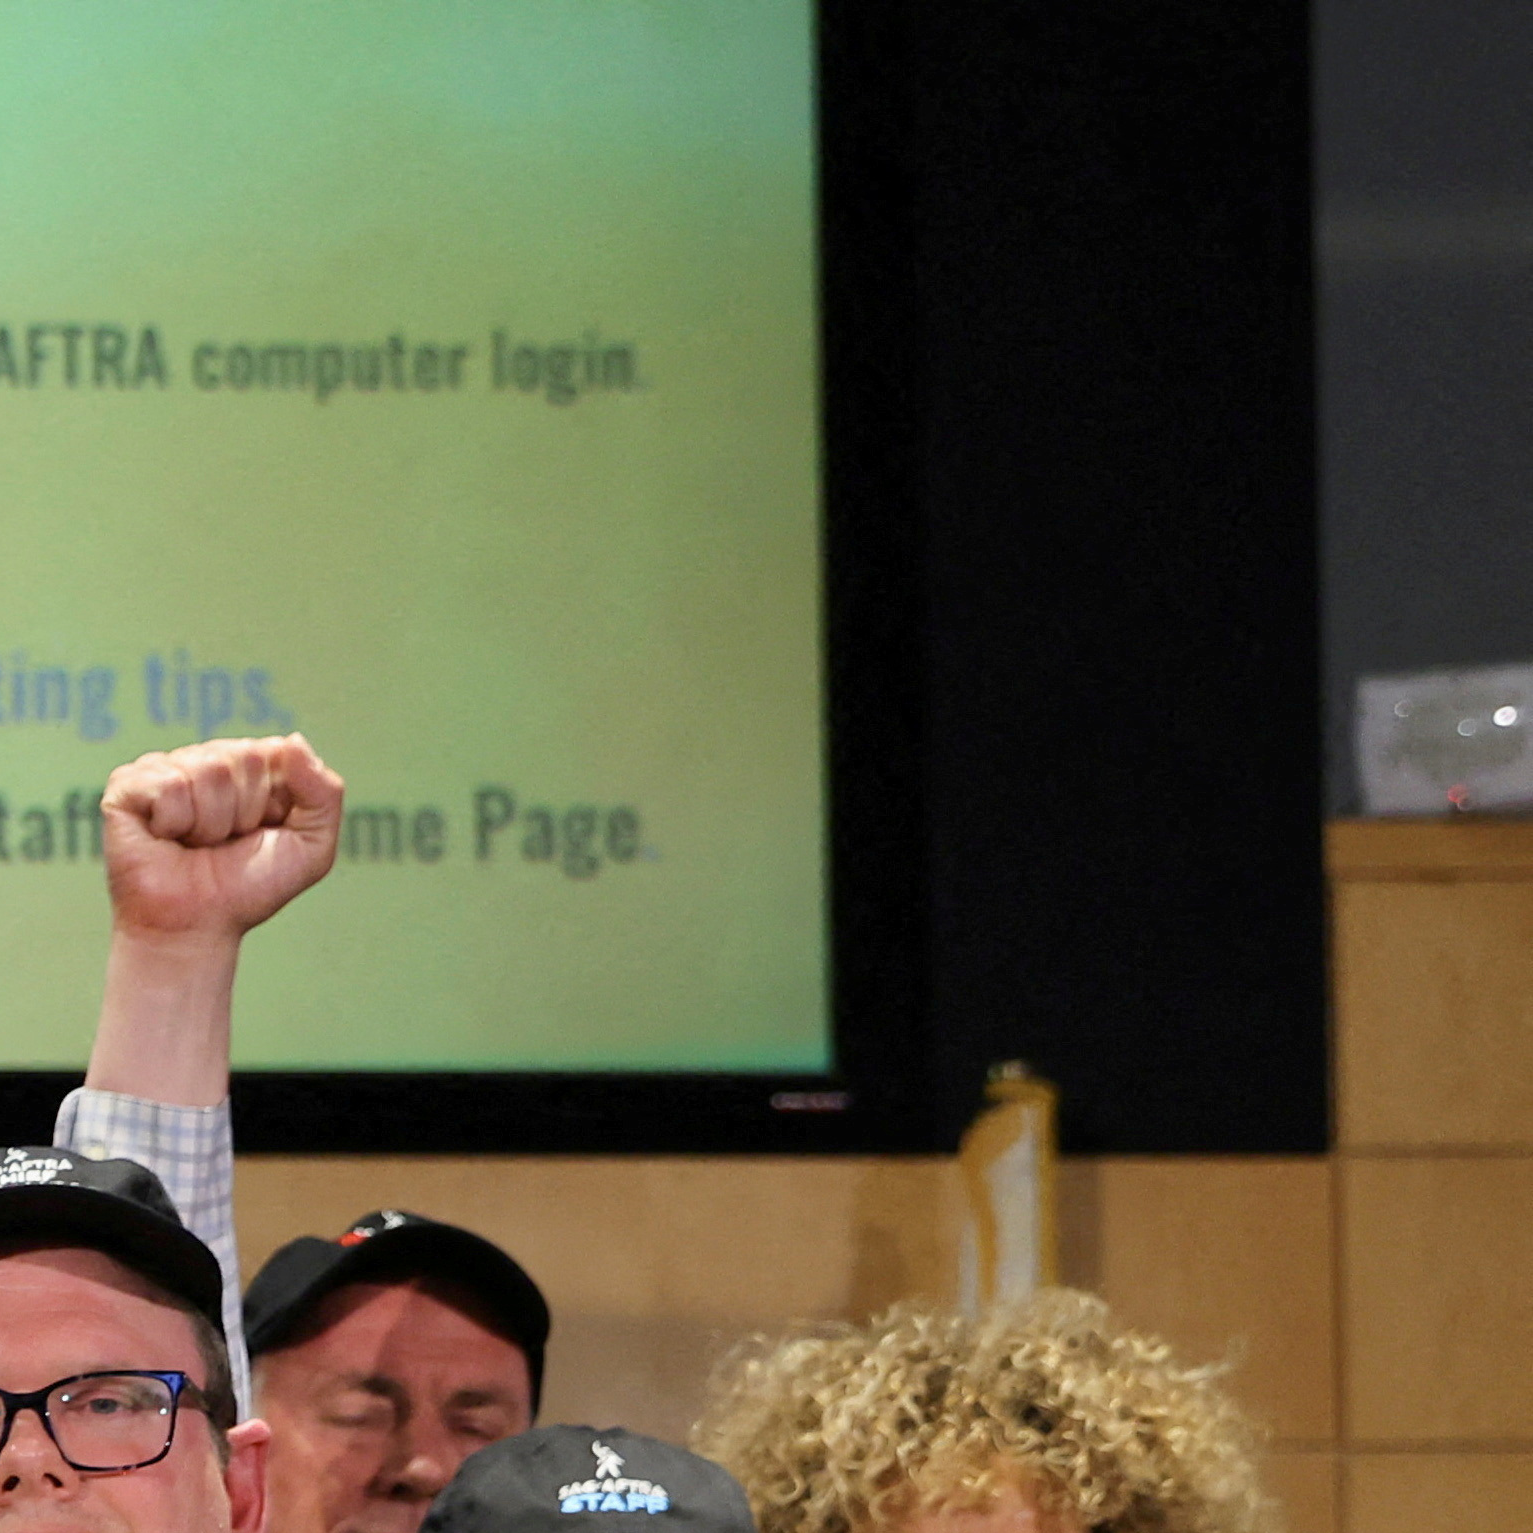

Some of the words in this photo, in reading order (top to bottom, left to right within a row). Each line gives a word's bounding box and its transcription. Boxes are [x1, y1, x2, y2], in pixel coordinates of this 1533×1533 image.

[190, 330, 470, 403] computer
[492, 326, 654, 405] login.
[560, 1491, 671, 1516] STAFF
